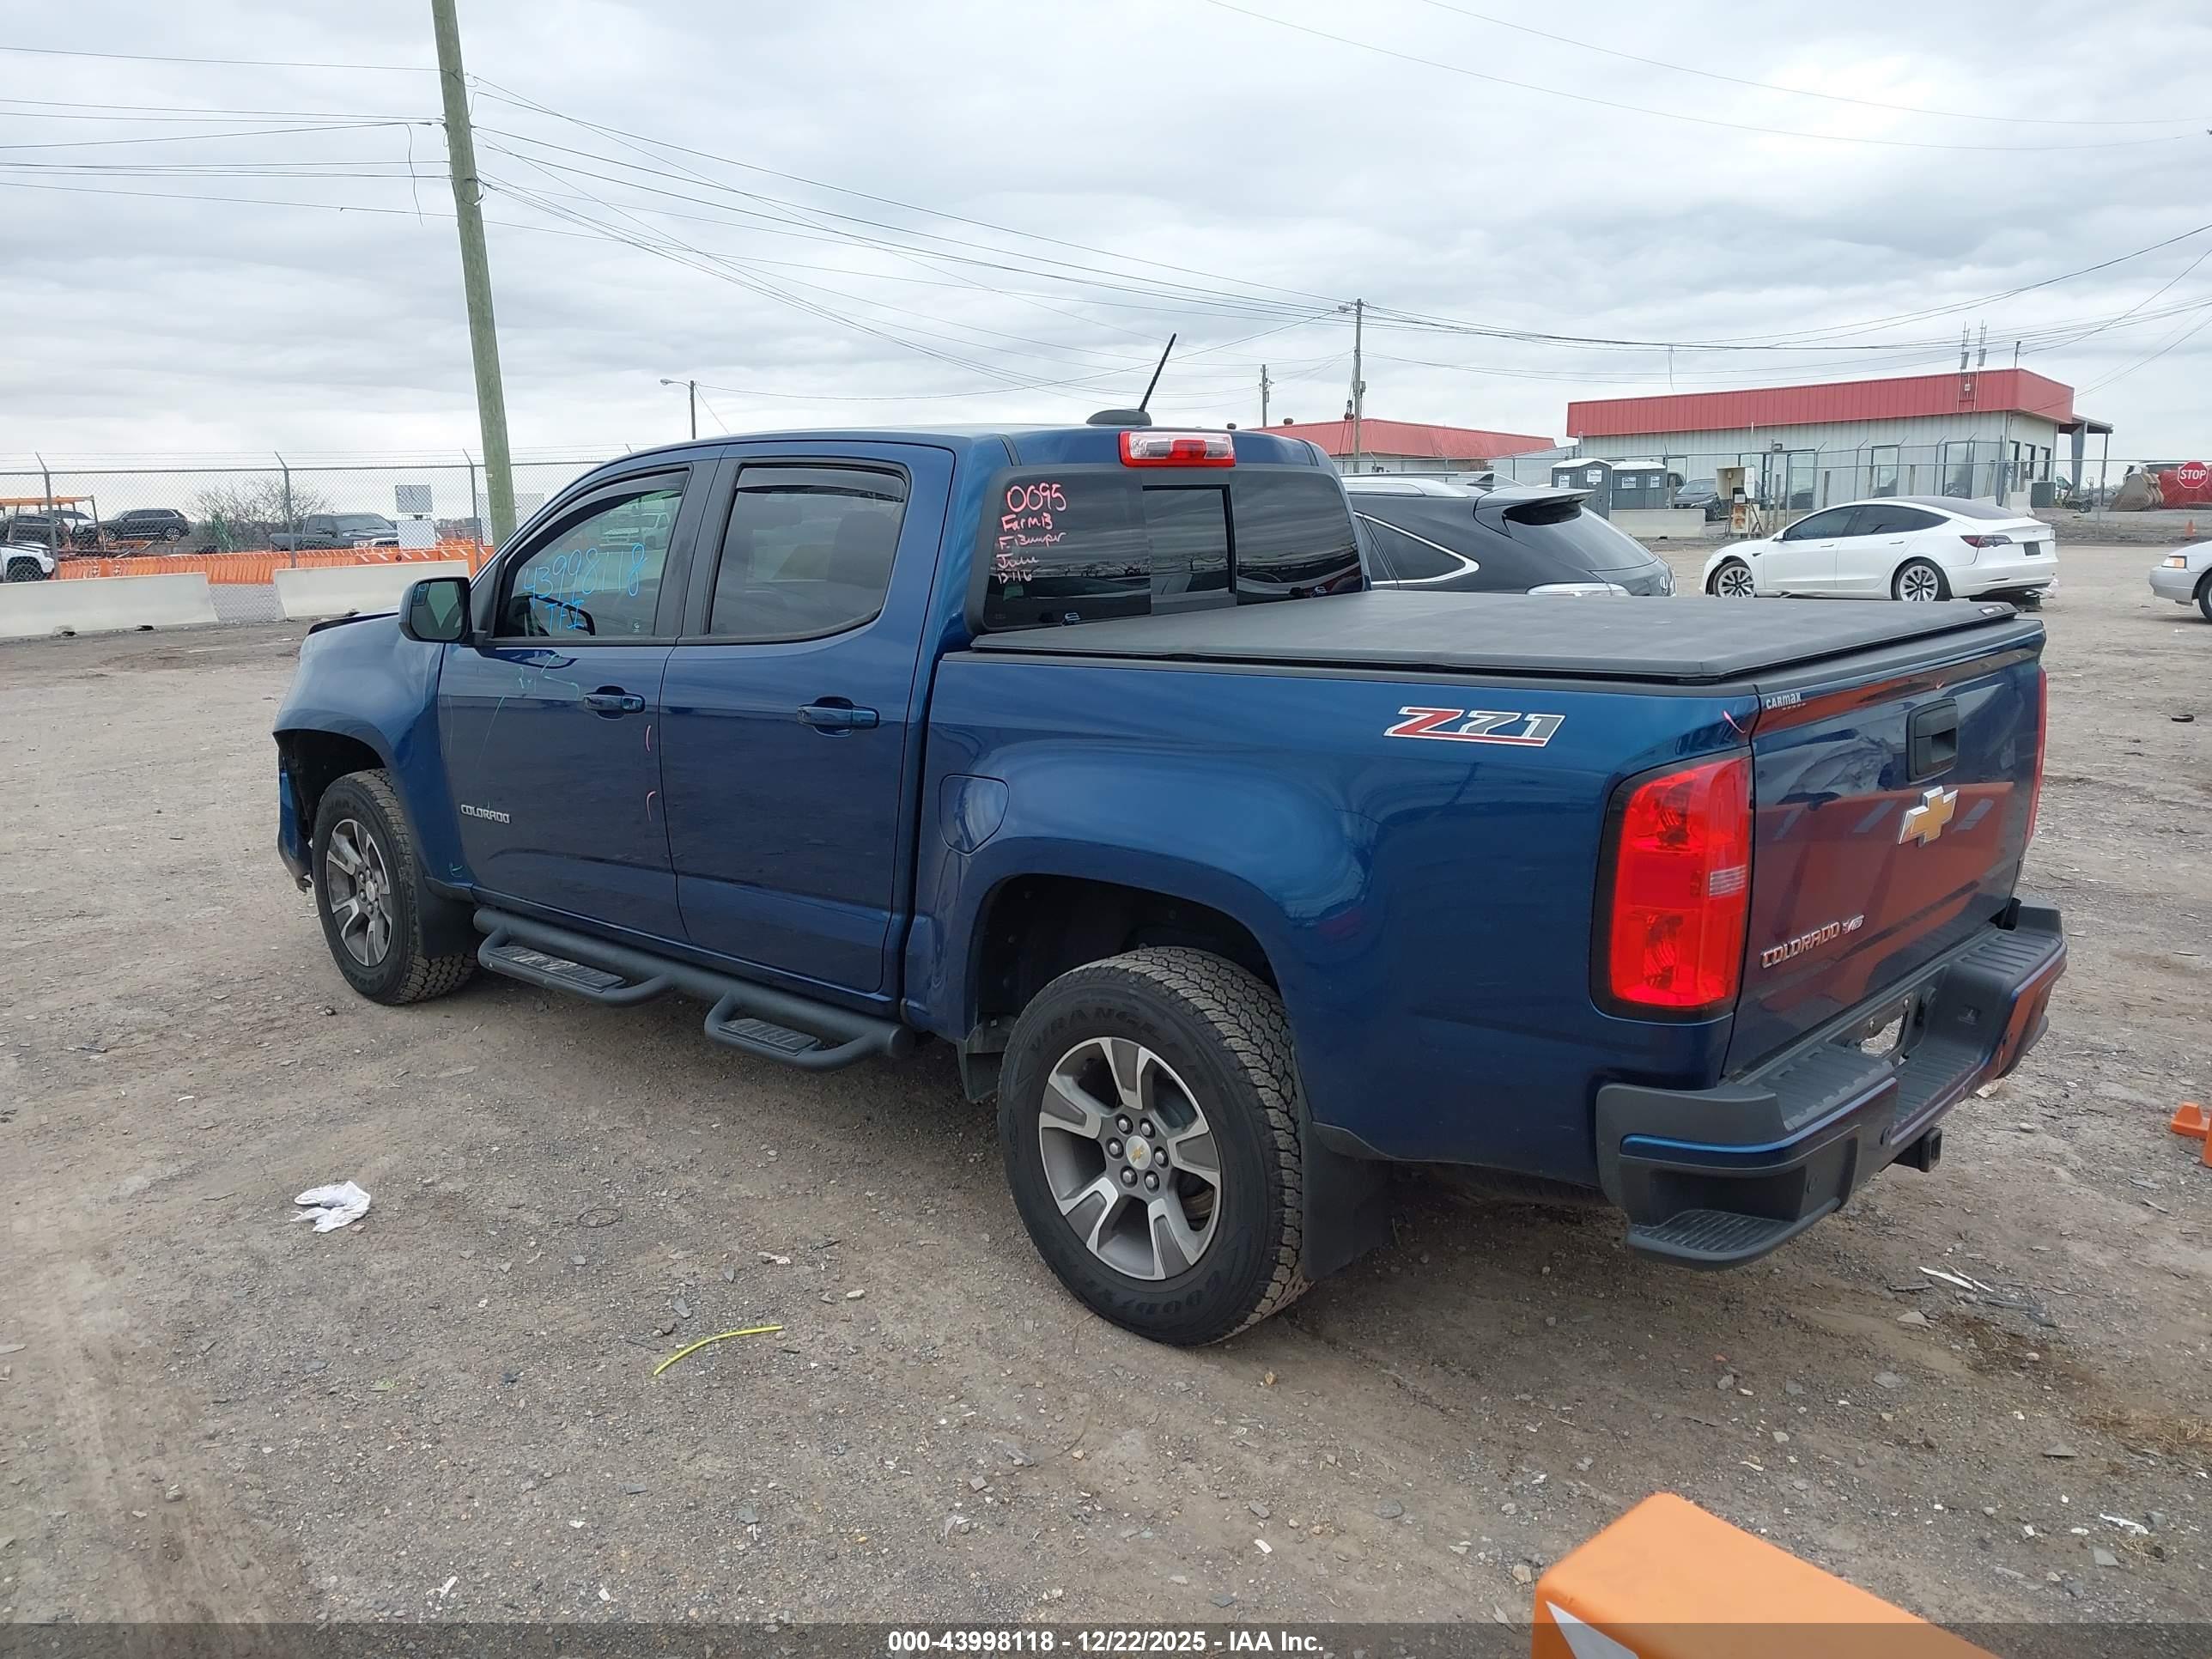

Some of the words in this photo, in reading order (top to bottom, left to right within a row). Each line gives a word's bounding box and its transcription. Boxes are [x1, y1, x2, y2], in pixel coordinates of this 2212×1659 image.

[2179, 469, 2207, 480] STOP
[1006, 482, 1066, 513] 0095
[522, 542, 648, 611] 43998118
[1382, 706, 1566, 747] Z71
[460, 804, 511, 824] COLORADO
[1761, 921, 1840, 969] COLORADO
